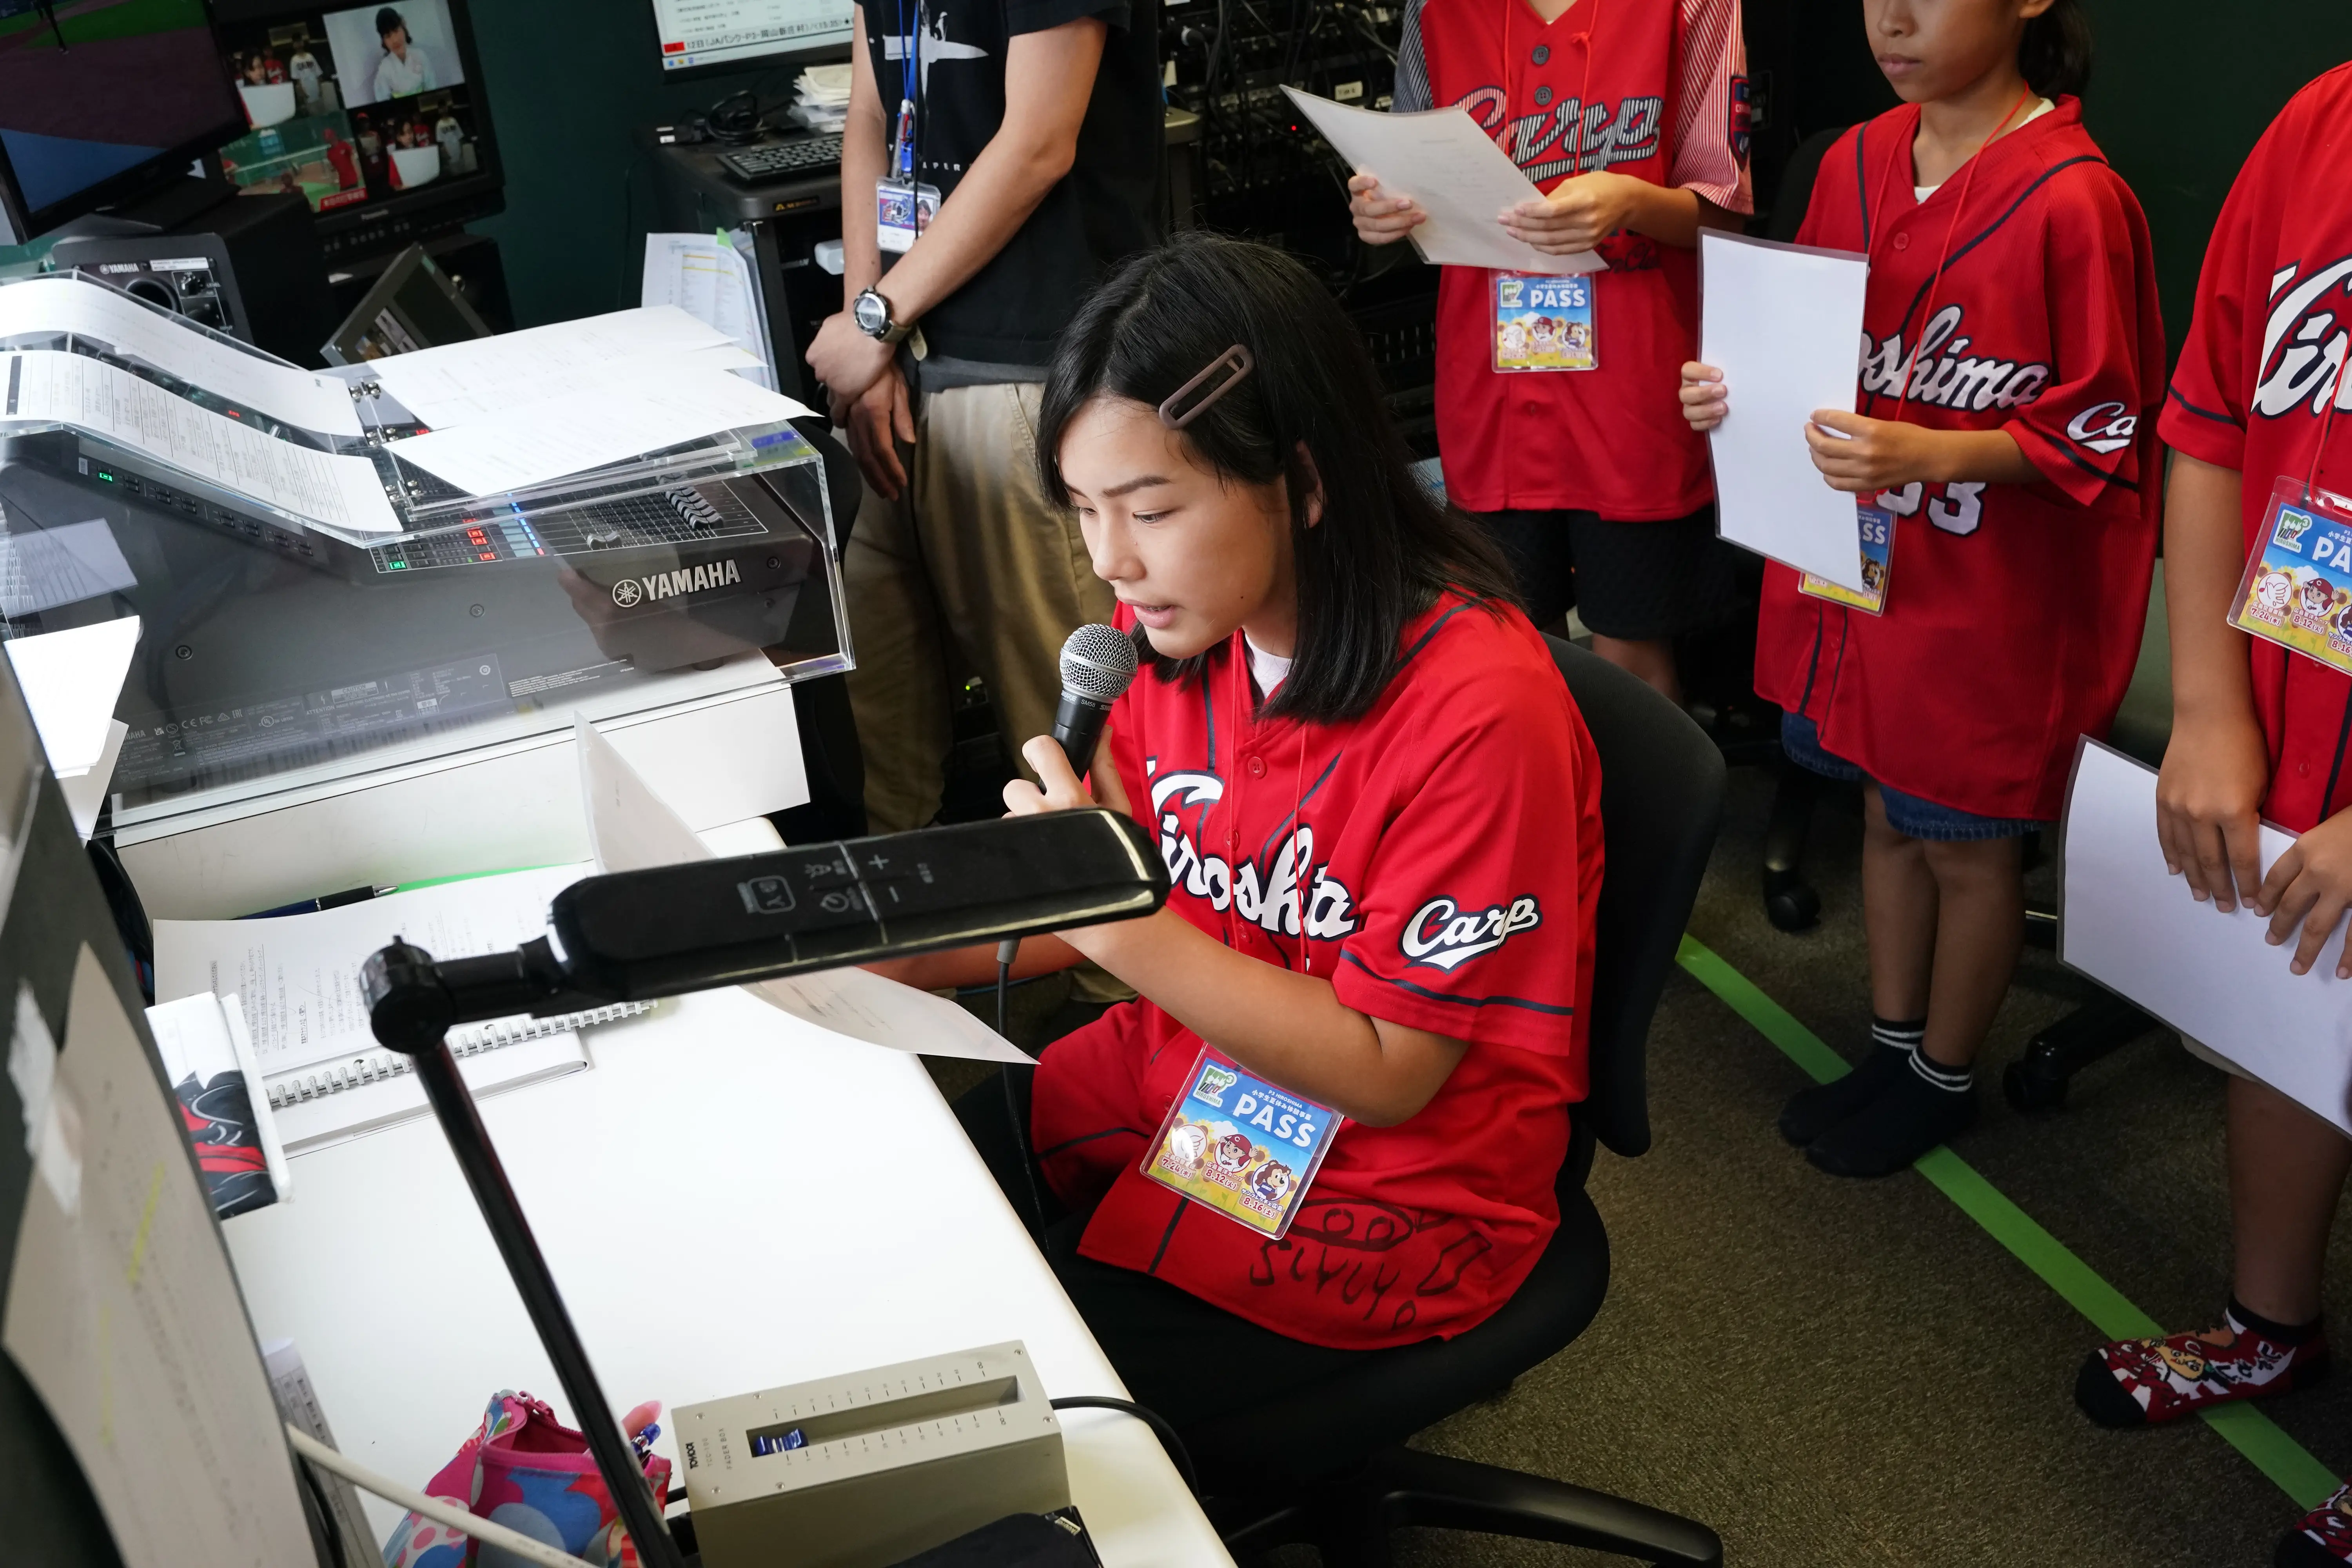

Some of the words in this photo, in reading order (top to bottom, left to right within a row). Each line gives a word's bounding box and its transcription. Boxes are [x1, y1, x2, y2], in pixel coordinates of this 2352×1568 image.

[109, 263, 140, 274] YAMAHA
[1530, 289, 1586, 307] PASS
[1861, 304, 2051, 413] shima
[1859, 522, 1886, 544] SS
[2276, 538, 2300, 550] HIROSHIMA
[642, 559, 741, 601] YAMAHA
[2251, 609, 2280, 625] 7.24(木)
[2294, 616, 2323, 633] 8.12(火)
[306, 705, 335, 715] ATTENTION
[1081, 699, 1096, 708] SM58
[1399, 894, 1542, 975] Carp
[1195, 1091, 1221, 1106] HIROSHIMA
[1252, 1090, 1312, 1120] 小学生夏休み体験事業
[1276, 1093, 1303, 1109] HIROSHIMA
[1232, 1094, 1316, 1147] PASS
[1162, 1159, 1191, 1177] 7.24(木)
[1206, 1171, 1236, 1190] 8.12(火)
[1207, 1162, 1245, 1182] 広島東洋カープ
[1241, 1188, 1283, 1212] サンフレッチェ広島
[1243, 1197, 1276, 1218] 8.16(土)
[717, 1428, 727, 1442] BOX
[721, 1444, 733, 1470] FADER
